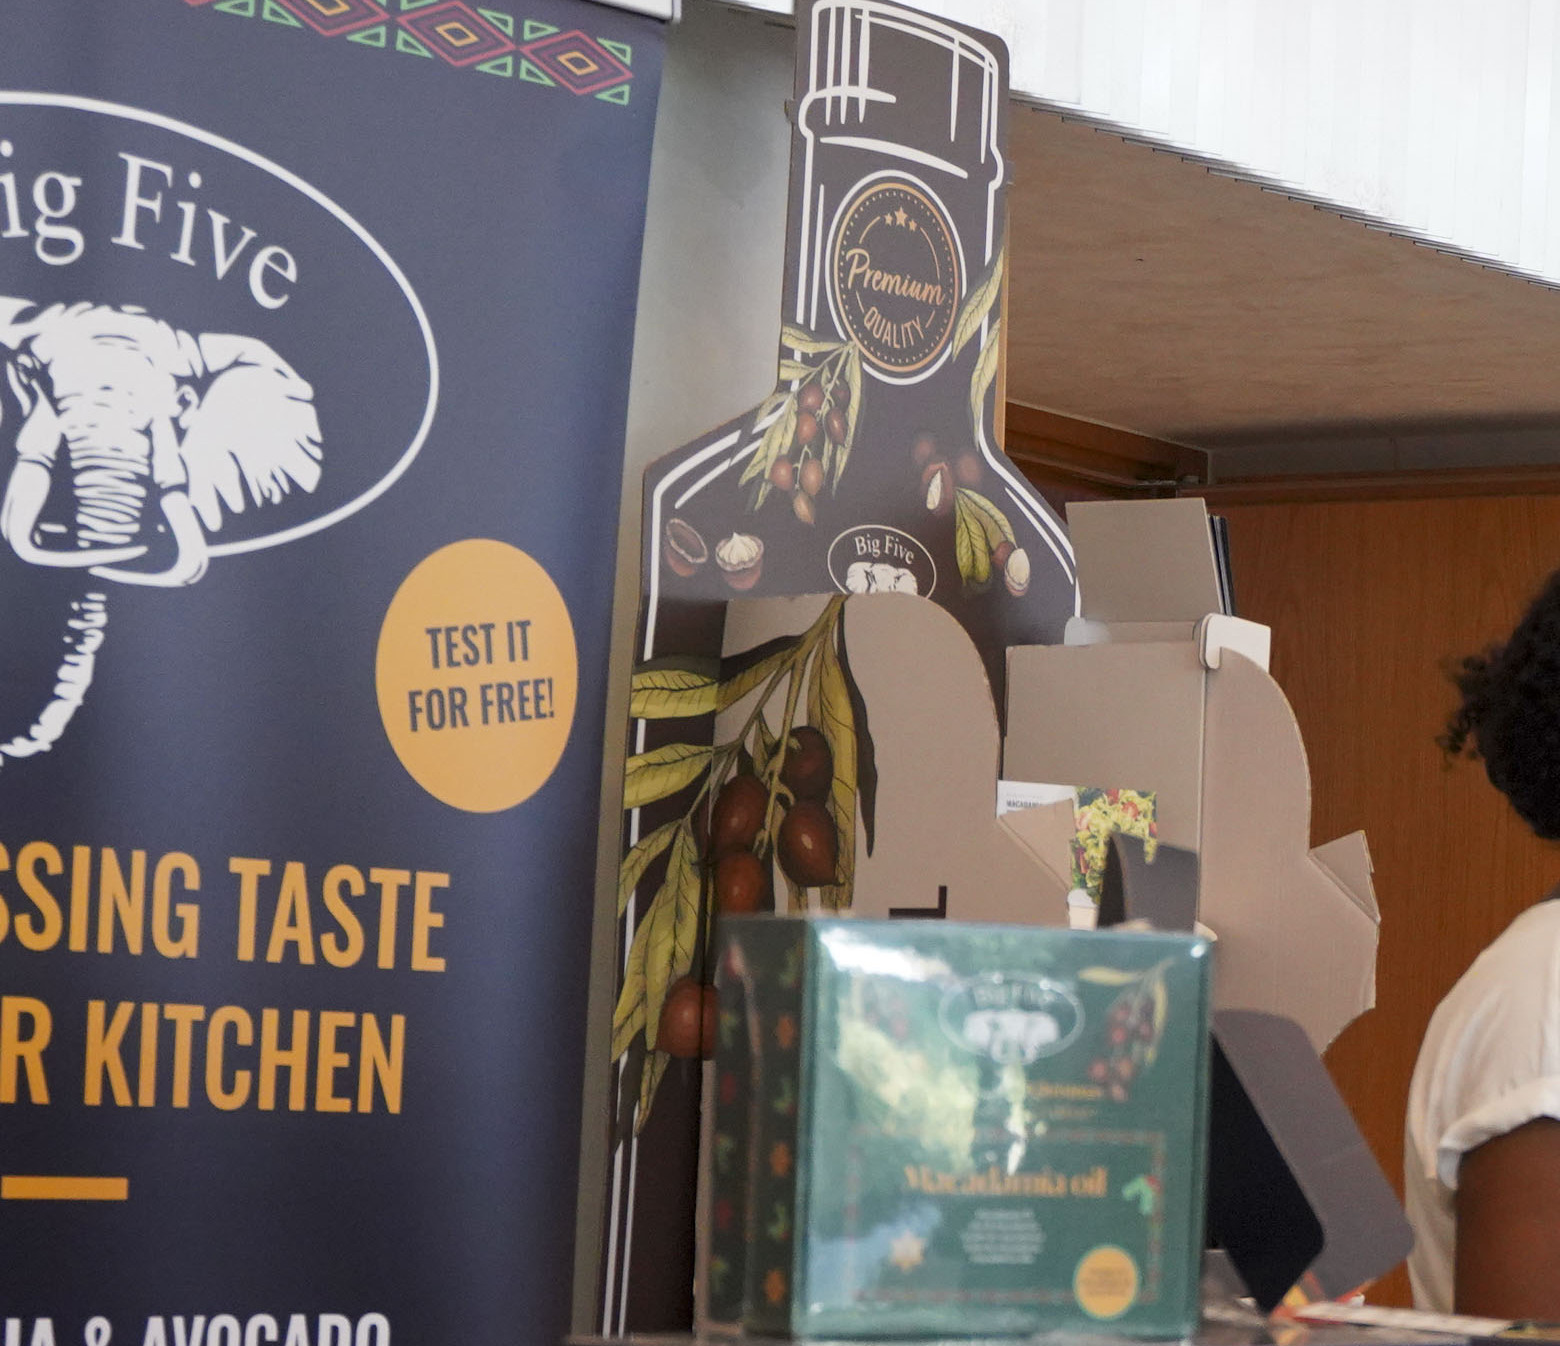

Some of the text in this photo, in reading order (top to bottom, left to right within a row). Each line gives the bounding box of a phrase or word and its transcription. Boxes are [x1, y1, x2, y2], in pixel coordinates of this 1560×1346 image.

[110, 152, 298, 309] Five
[846, 248, 946, 306] Premium
[863, 306, 924, 349] QUALITY
[855, 533, 915, 565] Big Five
[425, 619, 532, 670] TEST IT
[408, 676, 555, 732] FOR FREE!
[228, 856, 451, 972] TASTE
[83, 1001, 406, 1114] KITCHEN
